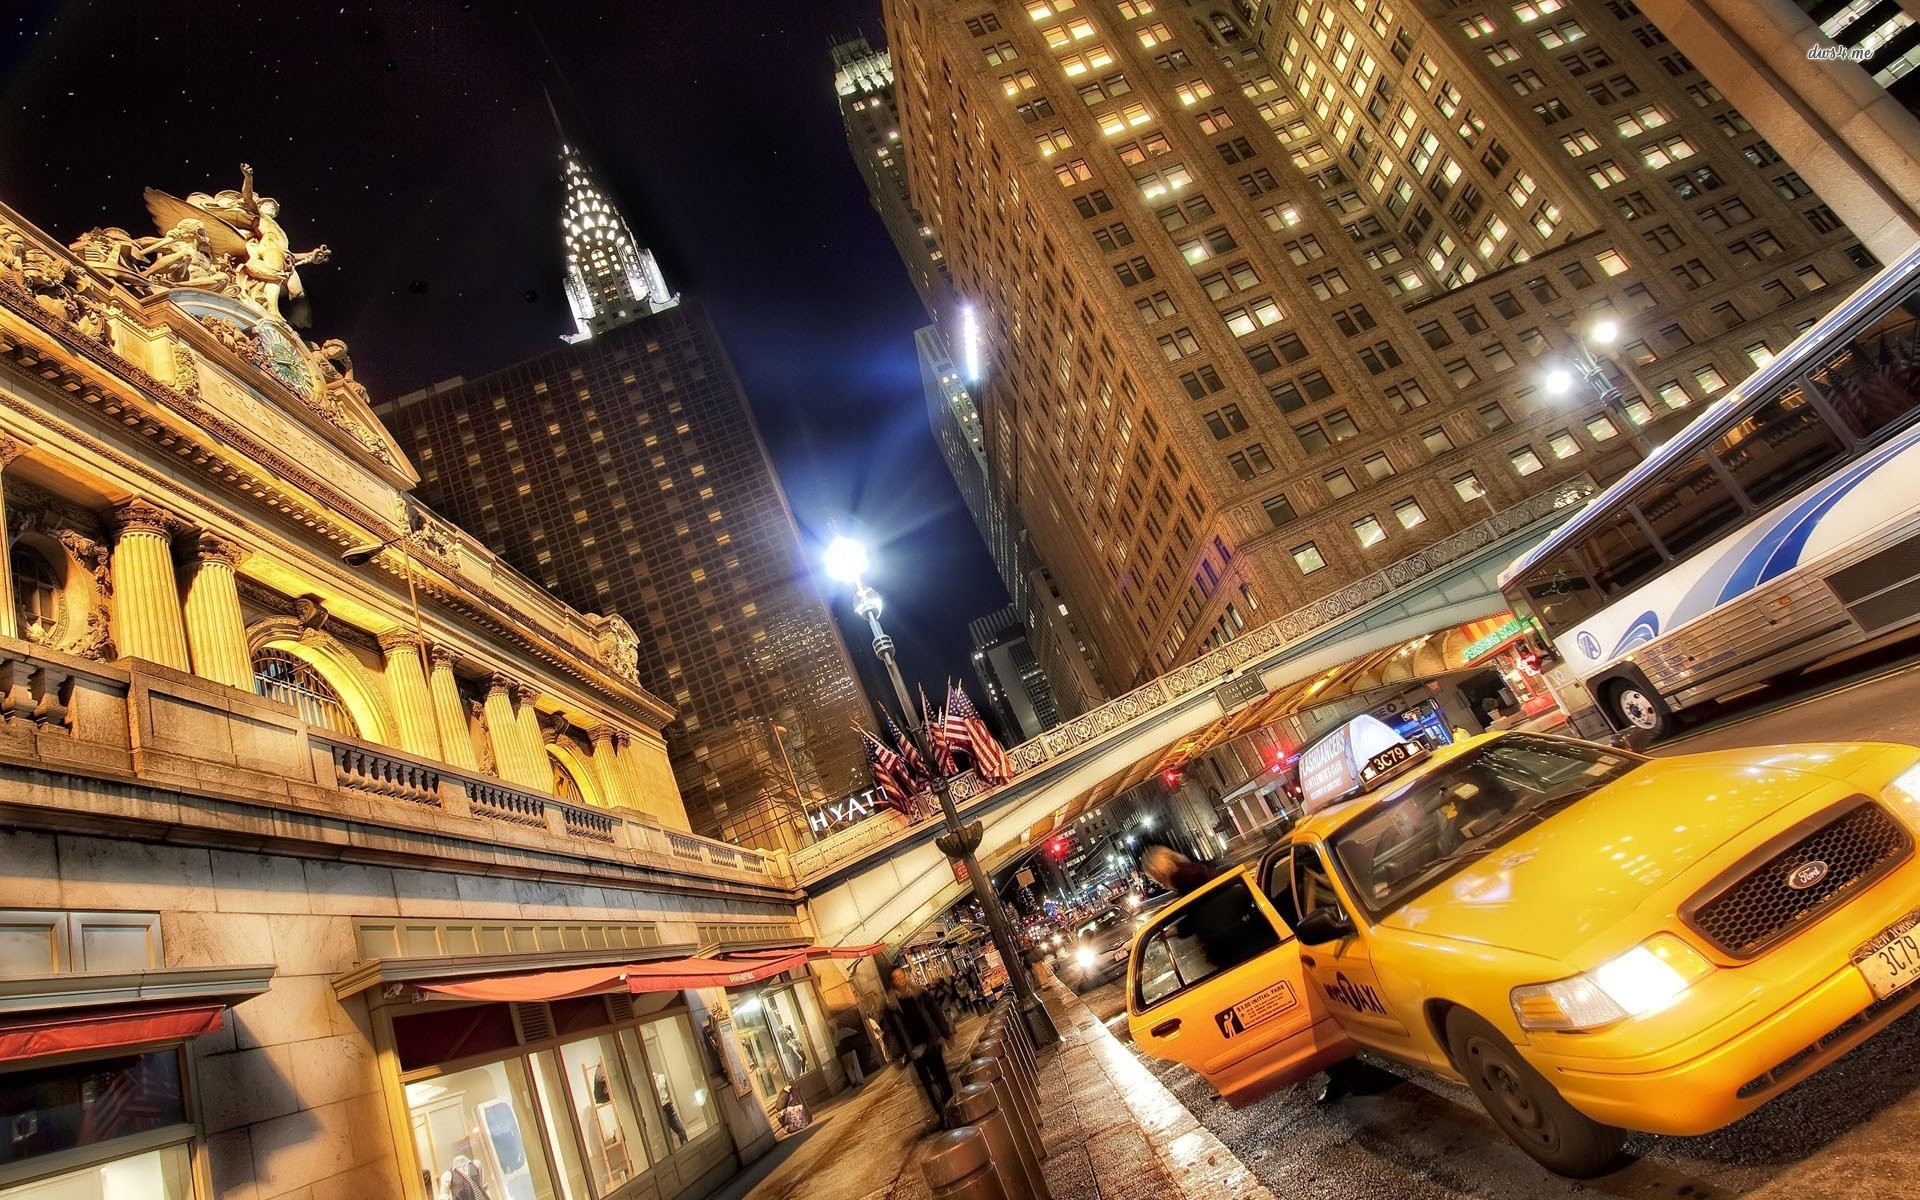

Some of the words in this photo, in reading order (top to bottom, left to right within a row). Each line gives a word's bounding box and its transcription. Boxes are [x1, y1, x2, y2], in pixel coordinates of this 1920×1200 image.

[1225, 679, 1254, 694] PERSHING
[1374, 747, 1405, 770] 3C79
[810, 786, 888, 831] HYATT
[1798, 866, 1820, 883] Ford
[1870, 931, 1890, 953] NEW
[1879, 935, 1920, 976] 3C79
[1251, 992, 1271, 1004] INITIAL
[1271, 984, 1285, 995] FARE
